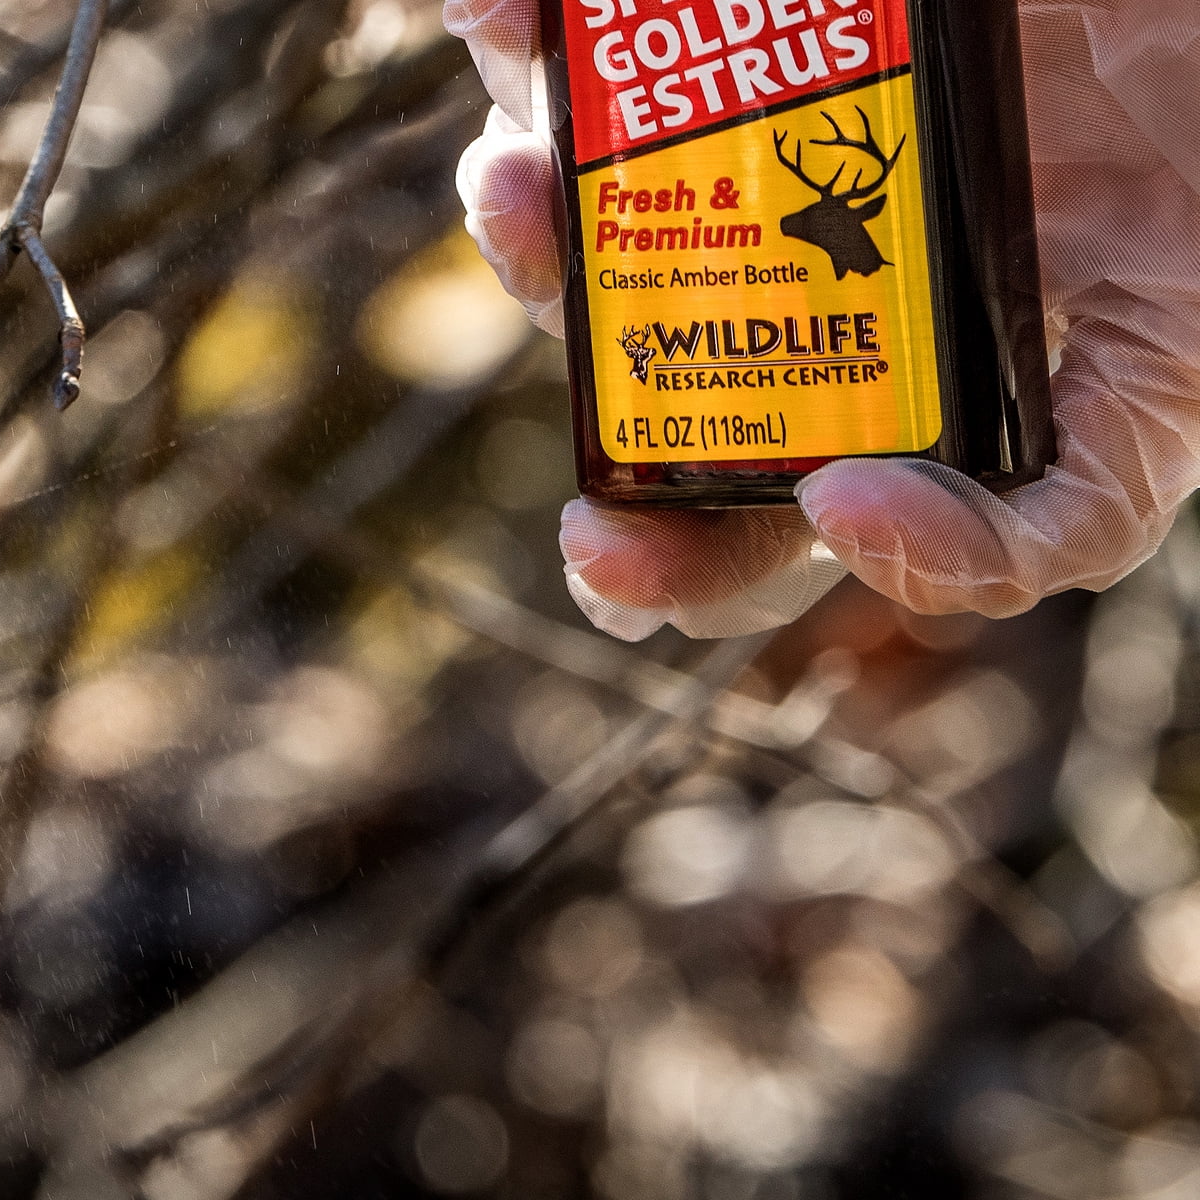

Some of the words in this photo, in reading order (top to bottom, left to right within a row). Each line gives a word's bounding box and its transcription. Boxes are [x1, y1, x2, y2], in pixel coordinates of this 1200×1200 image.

[598, 179, 696, 215] Fresh
[709, 177, 741, 210] &
[596, 217, 762, 252] Premium
[599, 268, 665, 290] Classic
[669, 266, 739, 288] Amber
[745, 262, 809, 285] Bottle
[652, 312, 880, 361] WILDLIFE
[655, 368, 776, 391] RESEARCH
[616, 418, 628, 449] 4
[634, 418, 658, 448] FL
[664, 416, 694, 448] OZ
